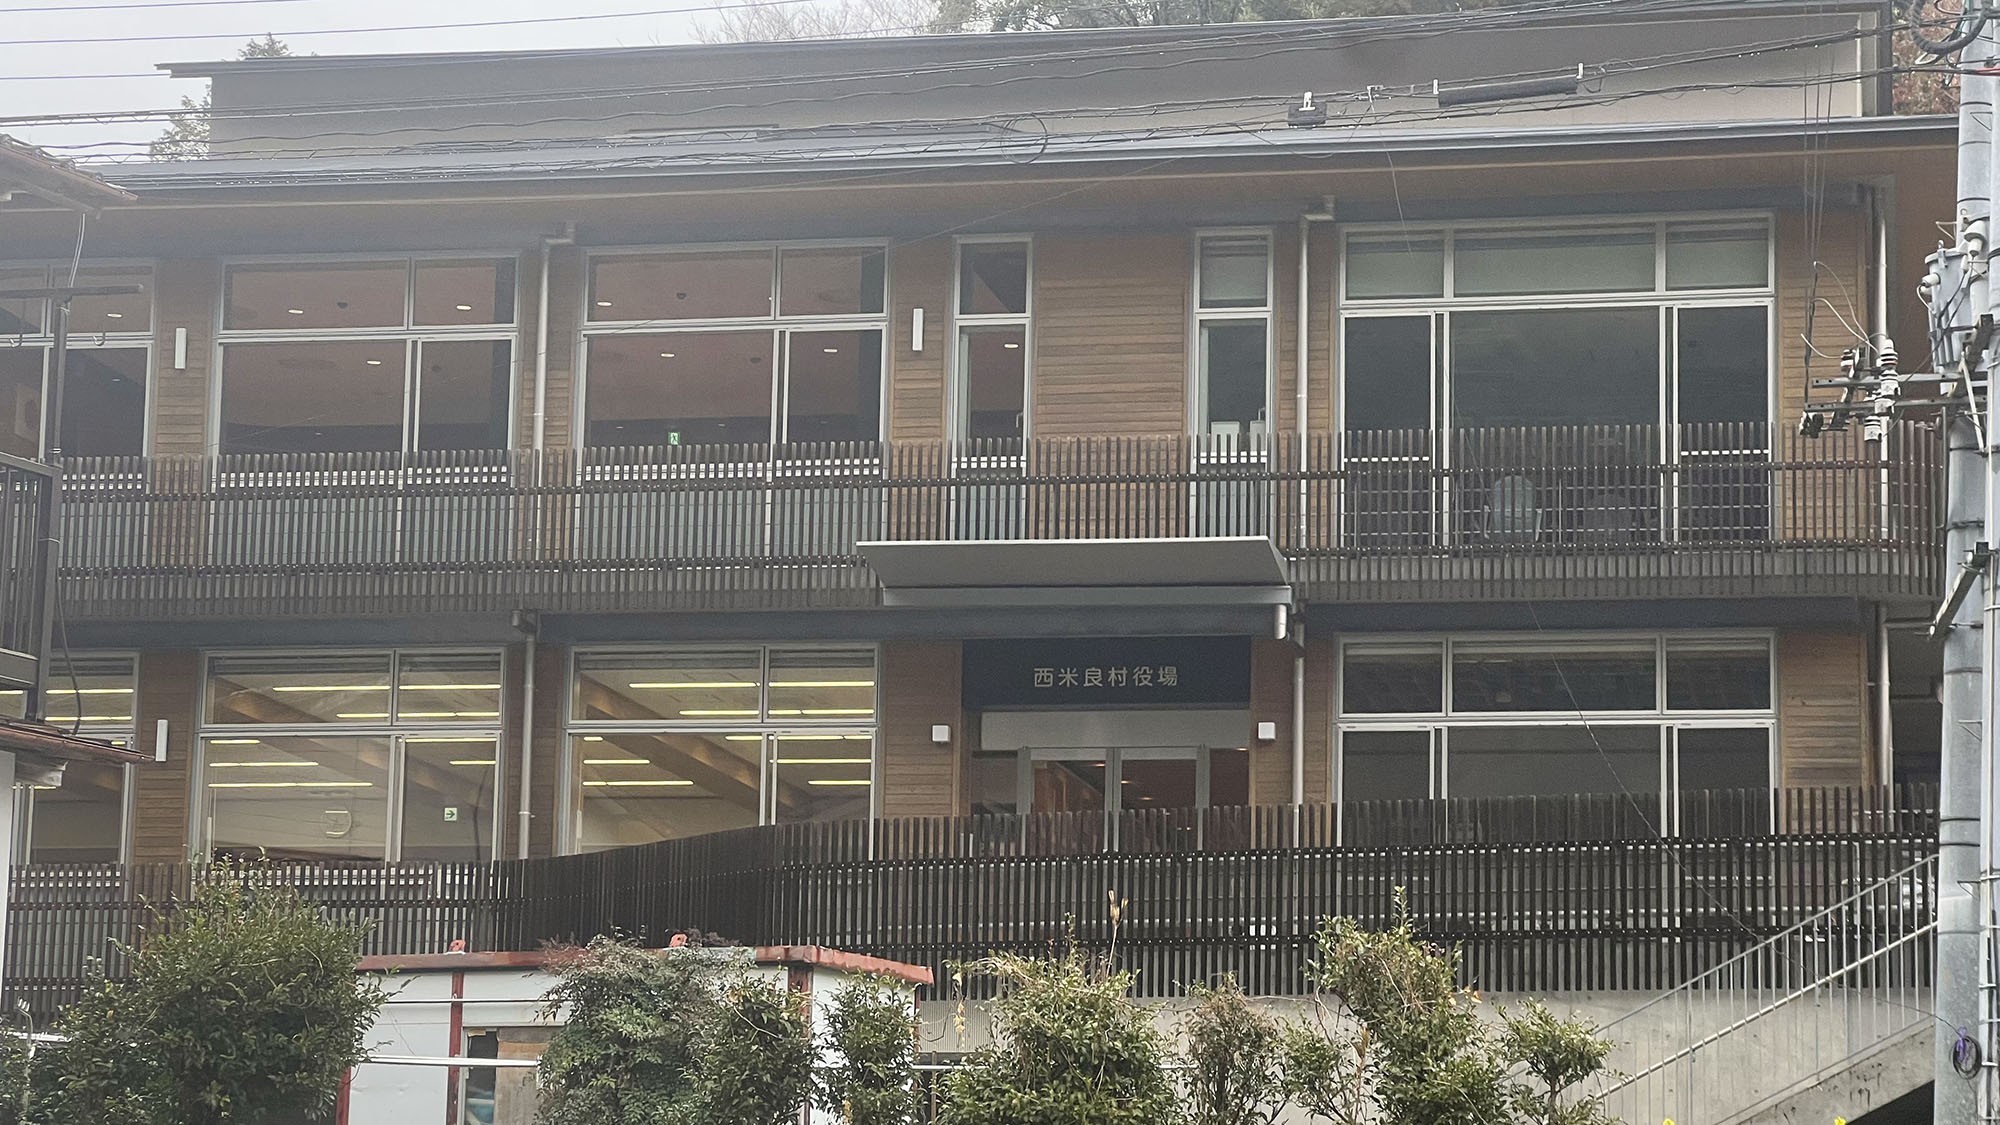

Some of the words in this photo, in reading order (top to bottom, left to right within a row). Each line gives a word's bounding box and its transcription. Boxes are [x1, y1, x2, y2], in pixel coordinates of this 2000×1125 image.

[1033, 666, 1178, 688] 西米良村役場
